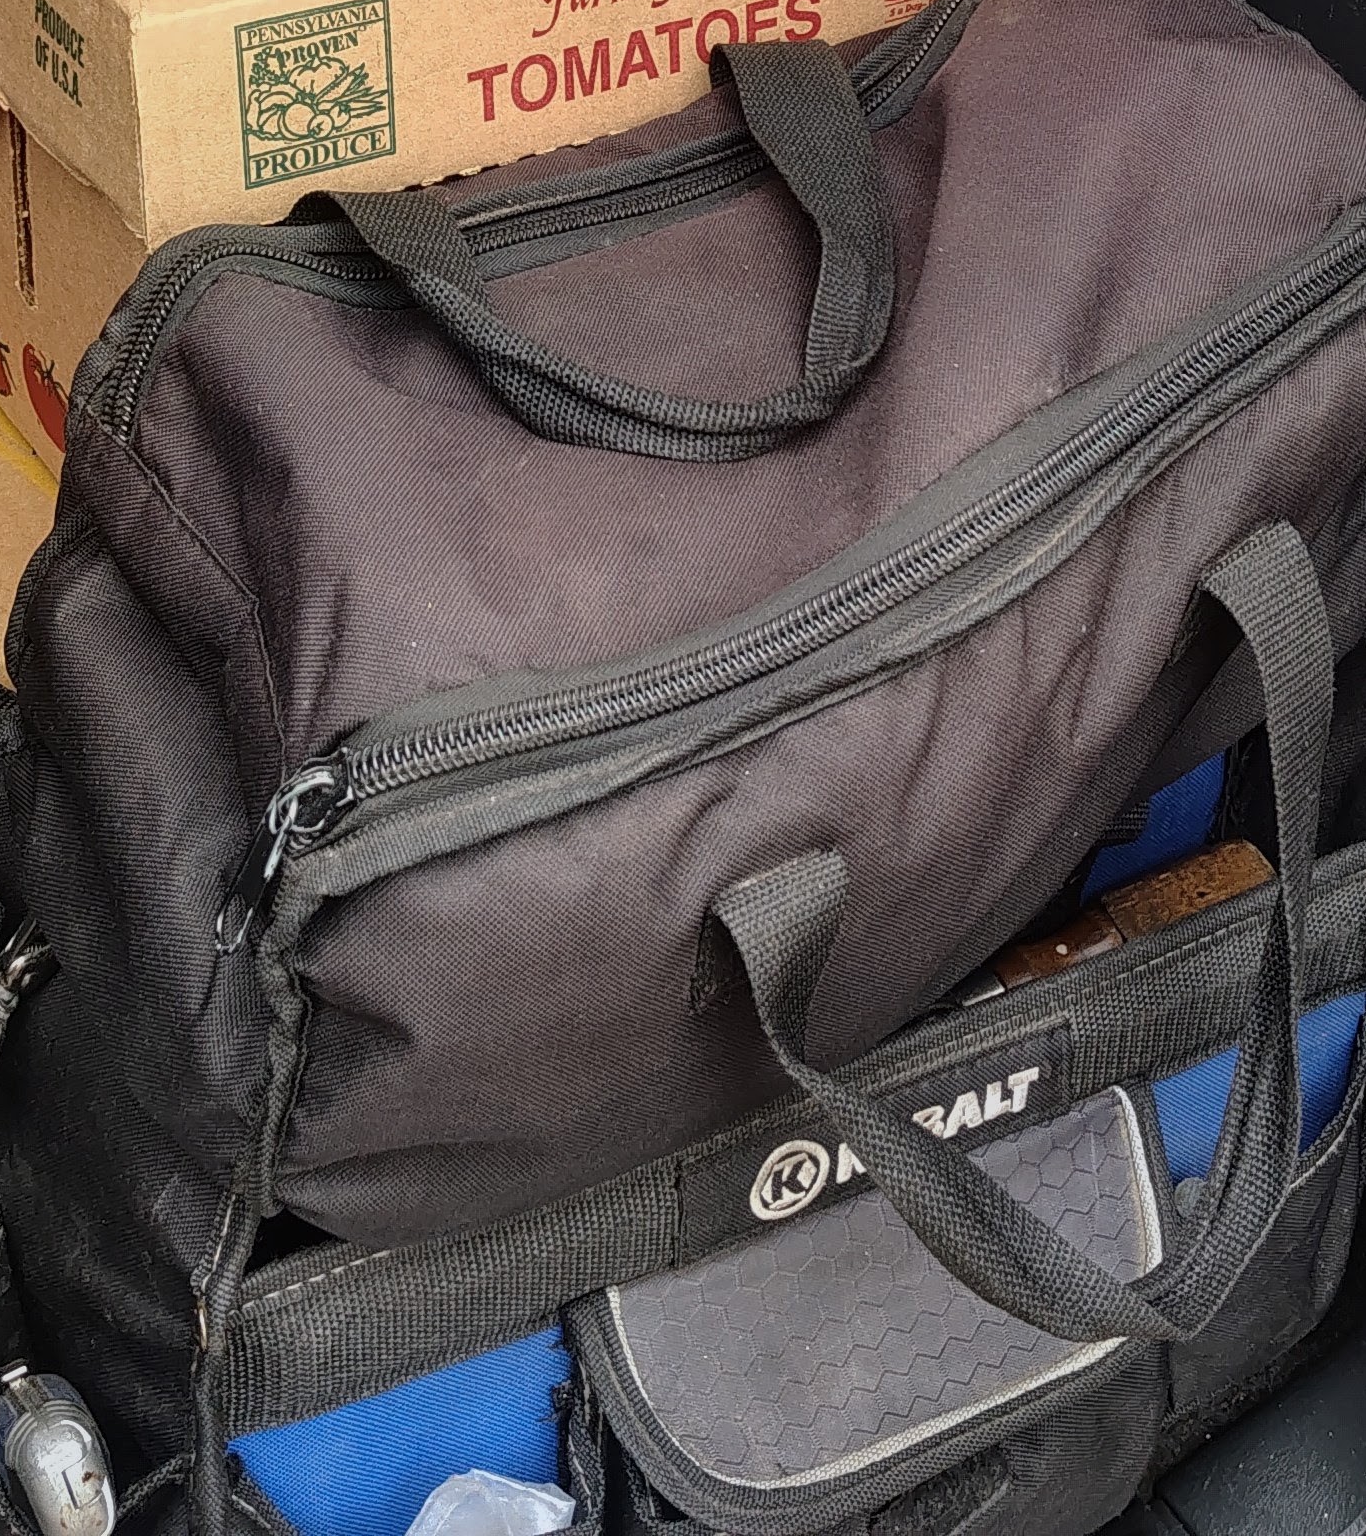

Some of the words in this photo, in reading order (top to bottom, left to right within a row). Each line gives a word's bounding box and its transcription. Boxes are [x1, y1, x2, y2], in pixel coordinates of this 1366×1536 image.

[245, 4, 381, 47] PENNSYLVANIA
[35, 34, 50, 72] OF
[282, 29, 359, 67] PROVEN
[252, 129, 387, 181] PRODUCE
